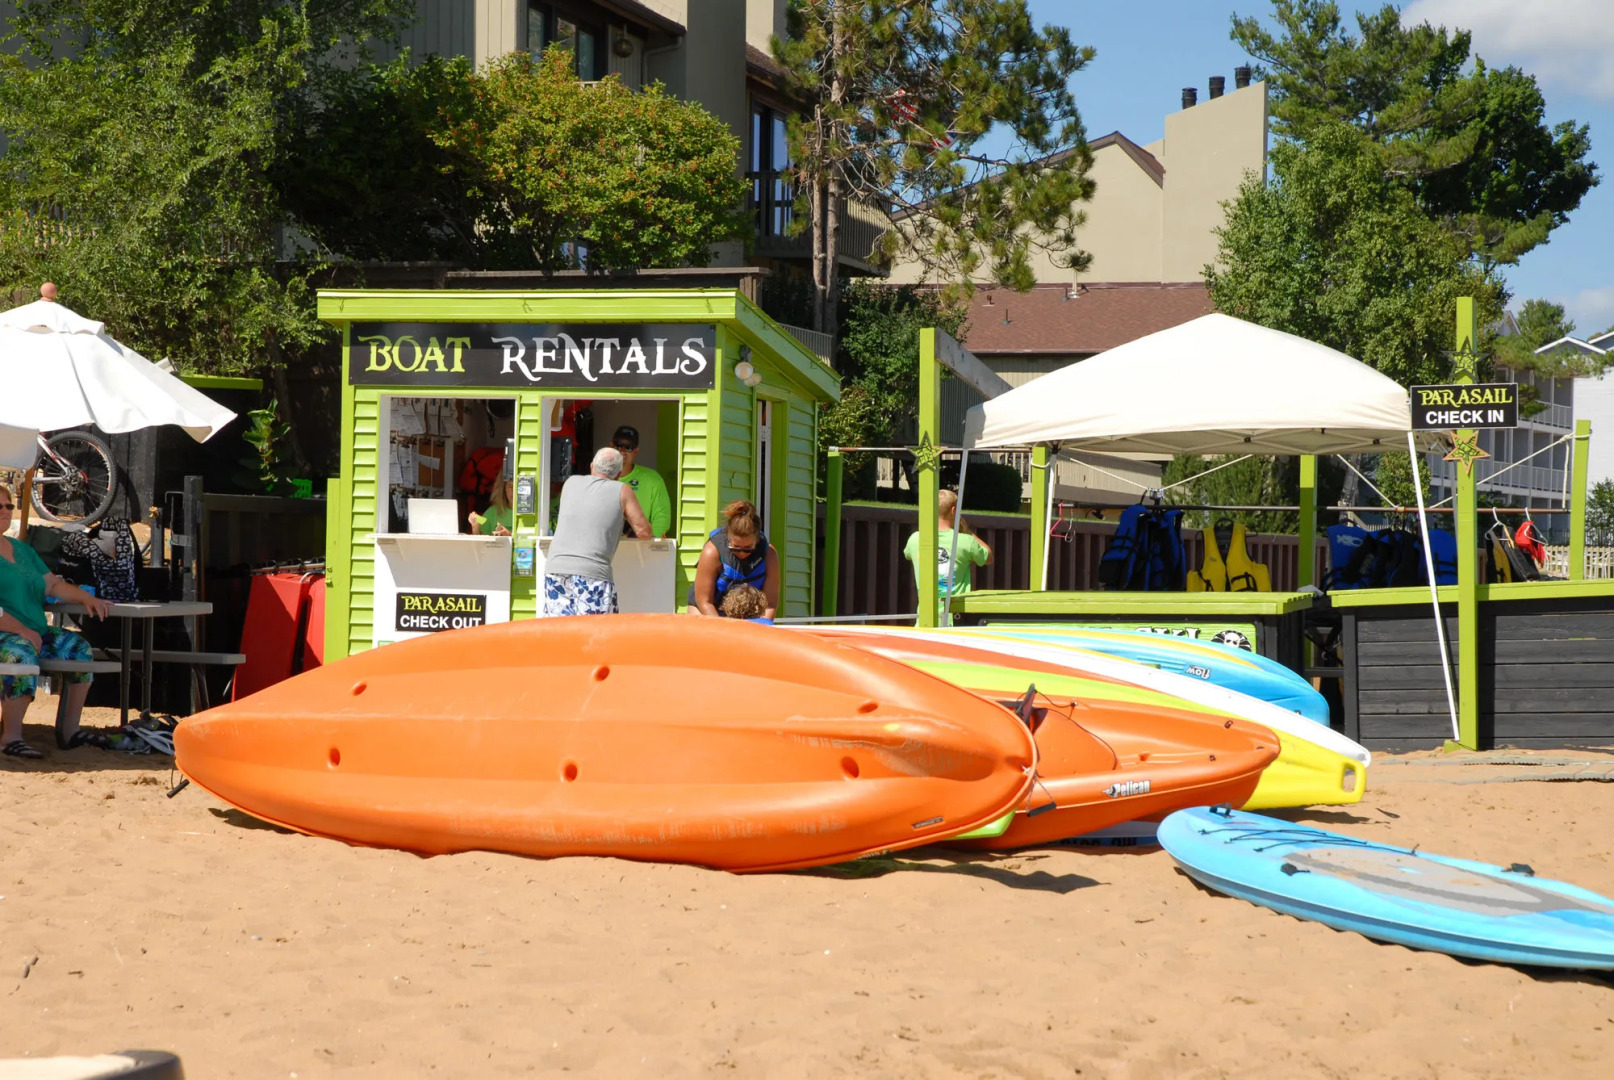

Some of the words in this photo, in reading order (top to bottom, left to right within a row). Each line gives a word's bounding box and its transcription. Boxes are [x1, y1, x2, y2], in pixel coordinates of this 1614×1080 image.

[357, 335, 472, 373] BOAT
[491, 332, 708, 382] RENTALS
[1417, 388, 1513, 408] PARASAIL
[1425, 410, 1484, 425] CHECK
[1487, 409, 1504, 423] IN
[401, 595, 482, 614] PARASAIL
[400, 615, 450, 629] CHECK
[452, 616, 482, 629] OUT
[1185, 664, 1211, 680] flow
[1108, 780, 1151, 798] Pelican
